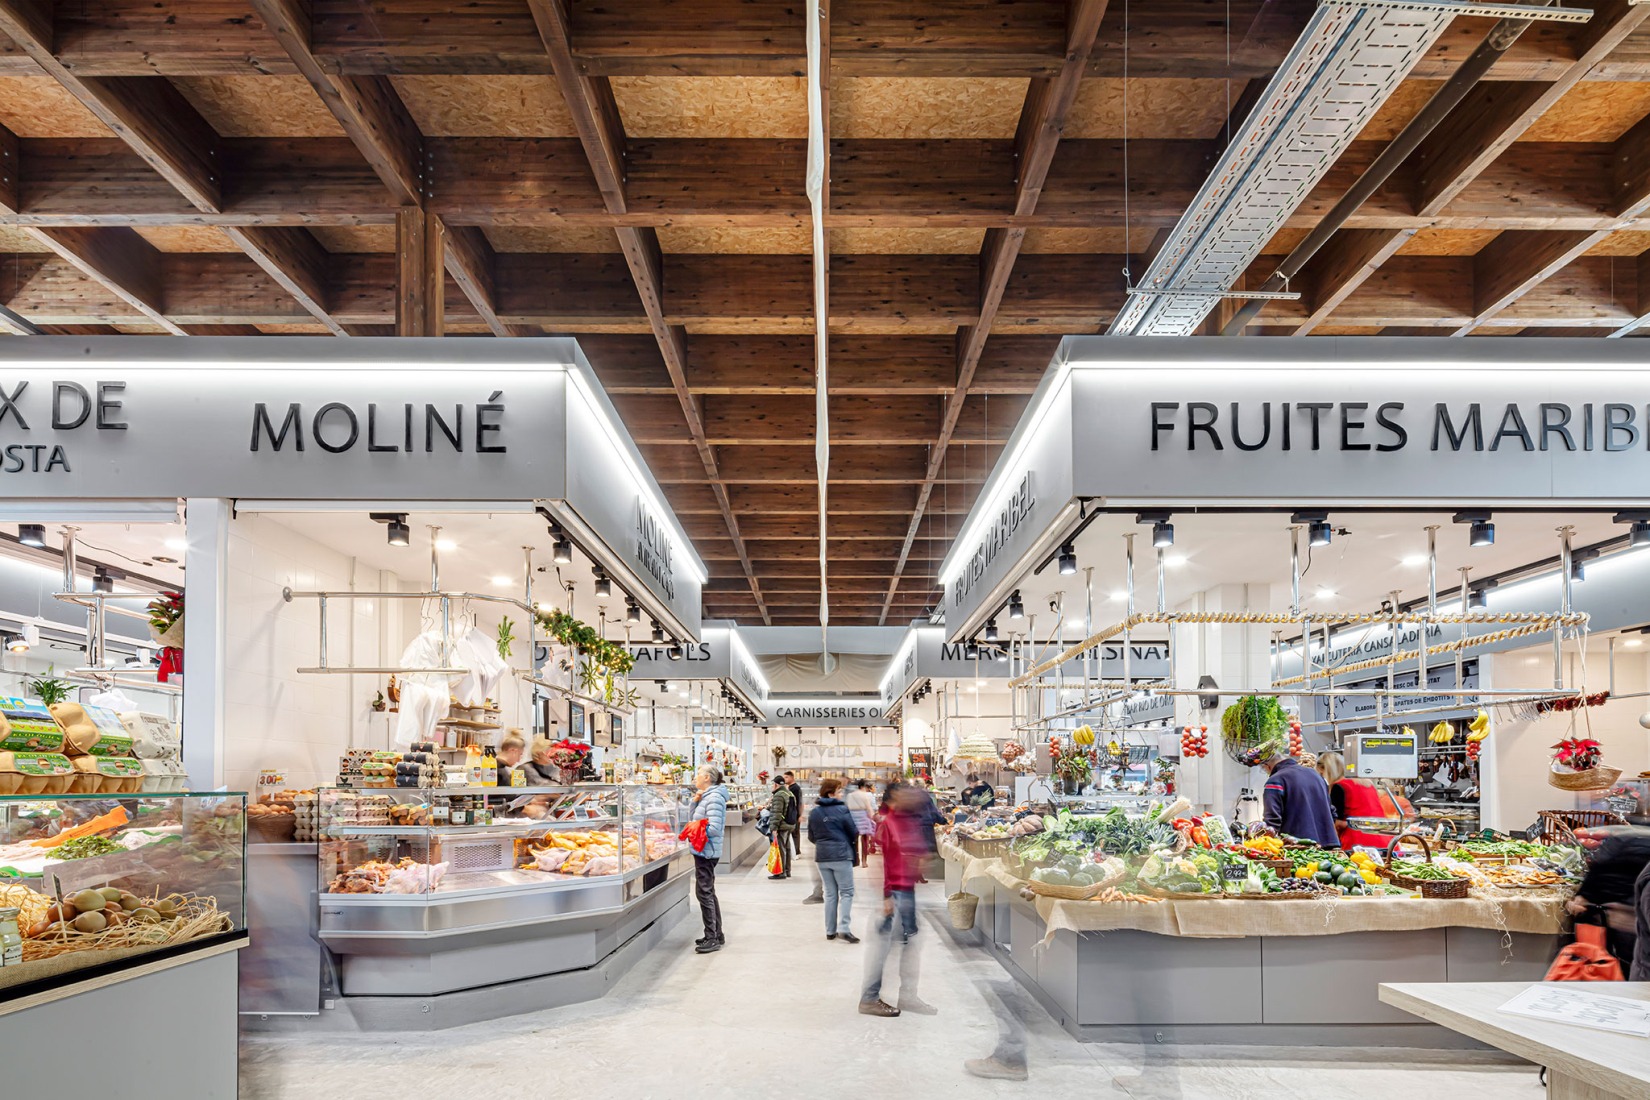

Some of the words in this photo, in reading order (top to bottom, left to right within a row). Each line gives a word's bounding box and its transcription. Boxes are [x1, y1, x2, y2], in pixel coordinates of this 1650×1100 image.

[52, 381, 128, 430] DE
[250, 391, 507, 453] MOLINÉ
[1151, 402, 1408, 451] FRUITES
[1431, 403, 1650, 451] MARIB
[0, 444, 71, 473] STA
[955, 542, 984, 607] FRUITES
[985, 470, 1035, 568] MARIBEL
[628, 642, 711, 661] AFOLS
[776, 707, 866, 718] CARNISSERIES
